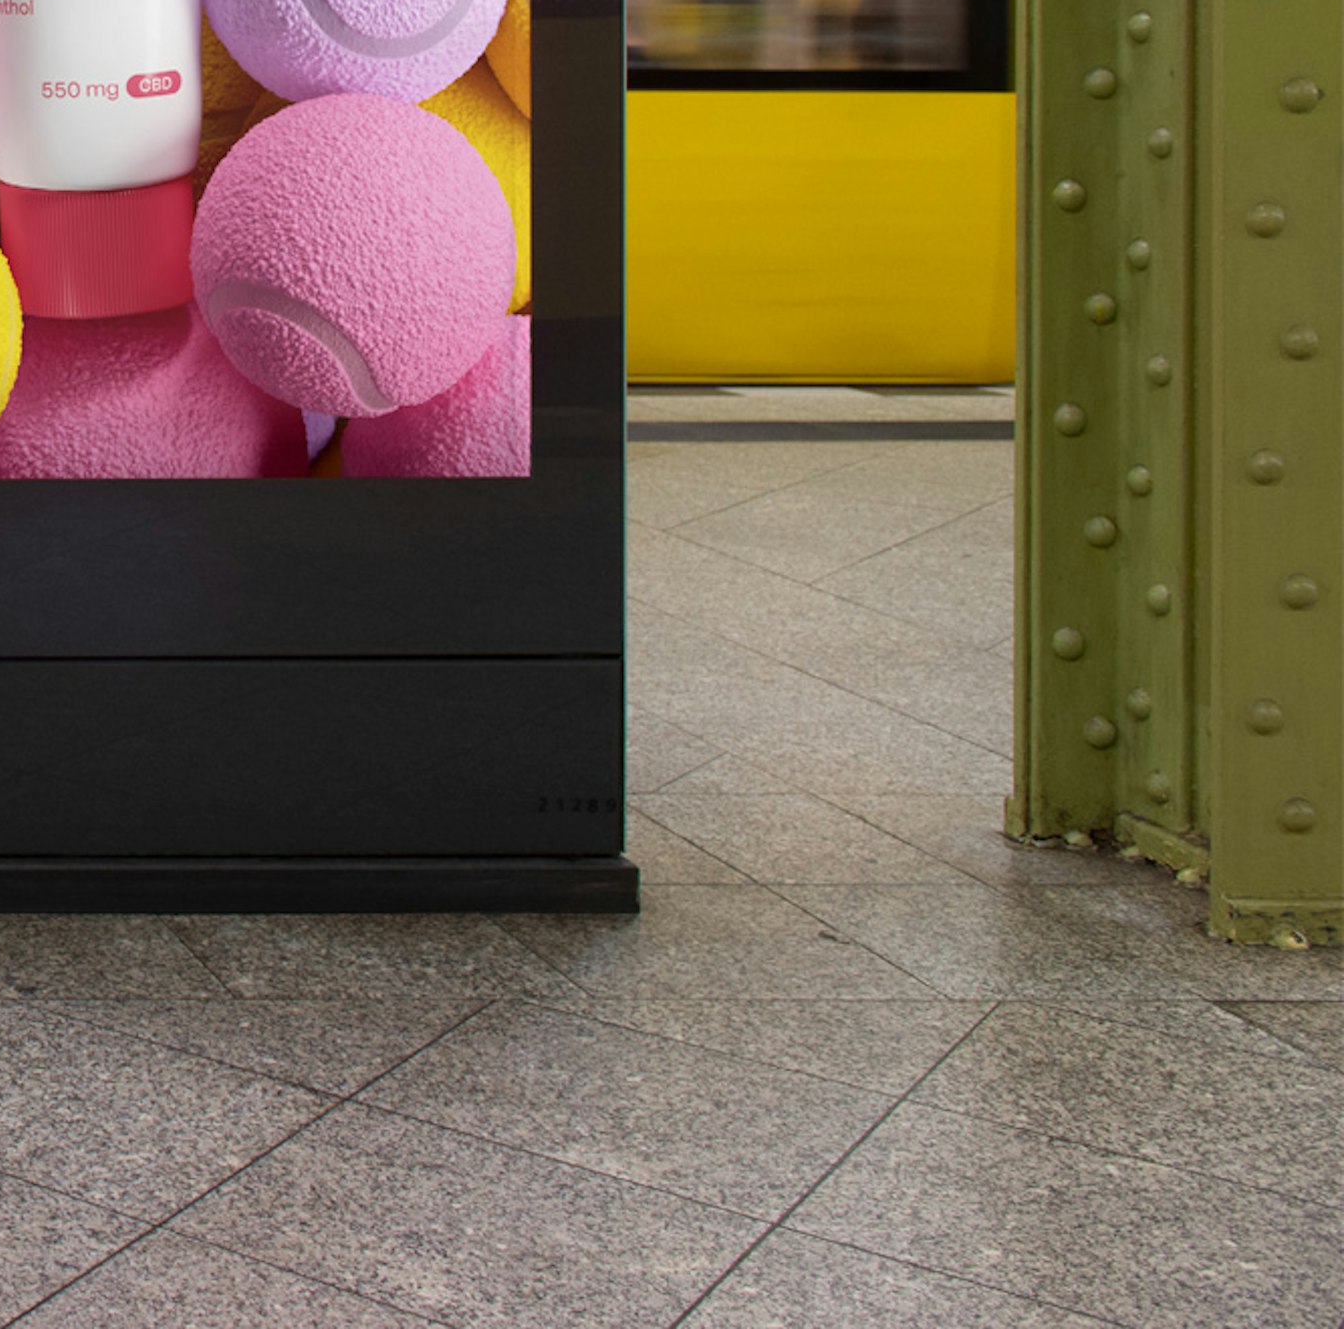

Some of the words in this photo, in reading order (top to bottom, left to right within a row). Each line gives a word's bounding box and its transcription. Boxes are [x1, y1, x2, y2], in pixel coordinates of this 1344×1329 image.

[41, 81, 81, 99] 550
[85, 82, 120, 102] mg
[138, 76, 173, 93] CBD
